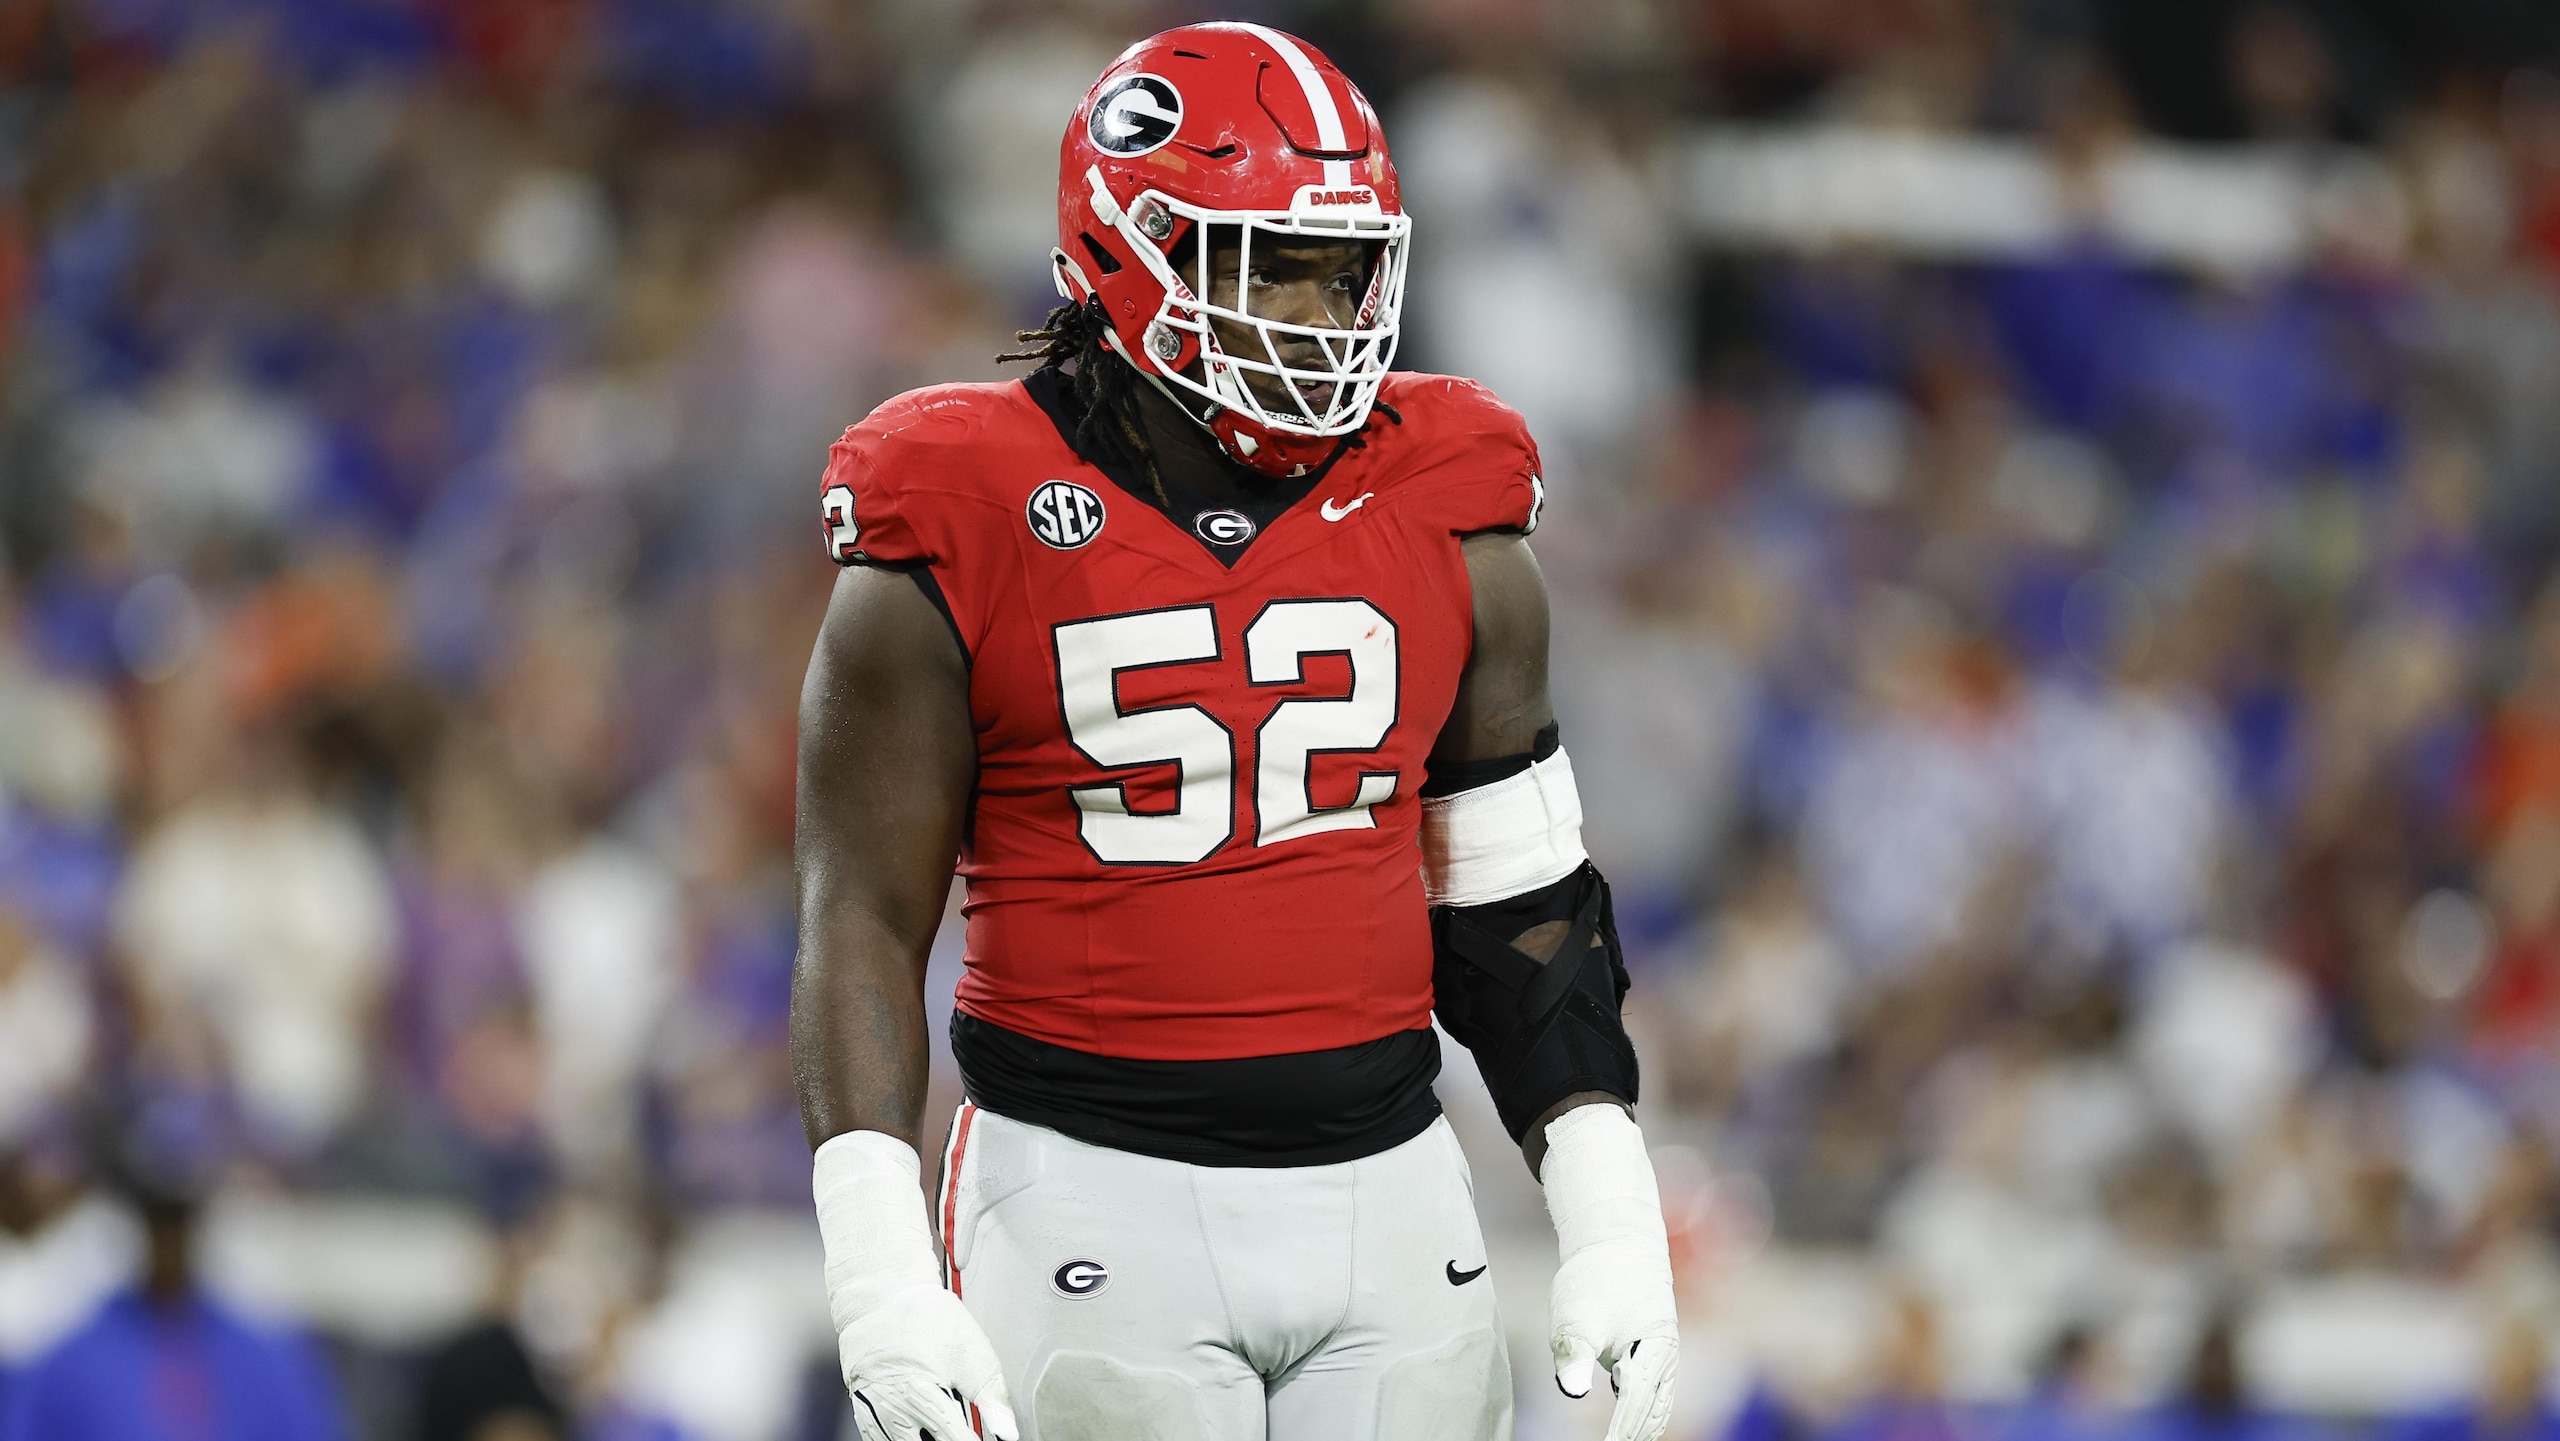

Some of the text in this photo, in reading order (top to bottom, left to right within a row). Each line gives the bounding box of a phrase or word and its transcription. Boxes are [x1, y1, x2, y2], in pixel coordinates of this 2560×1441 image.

[1096, 80, 1182, 148] G
[1310, 190, 1372, 206] DAWGS
[821, 483, 870, 561] 2
[1032, 484, 1099, 544] SEC
[1203, 514, 1251, 541] G
[1050, 596, 1400, 867] 52
[1060, 1262, 1108, 1291] G
